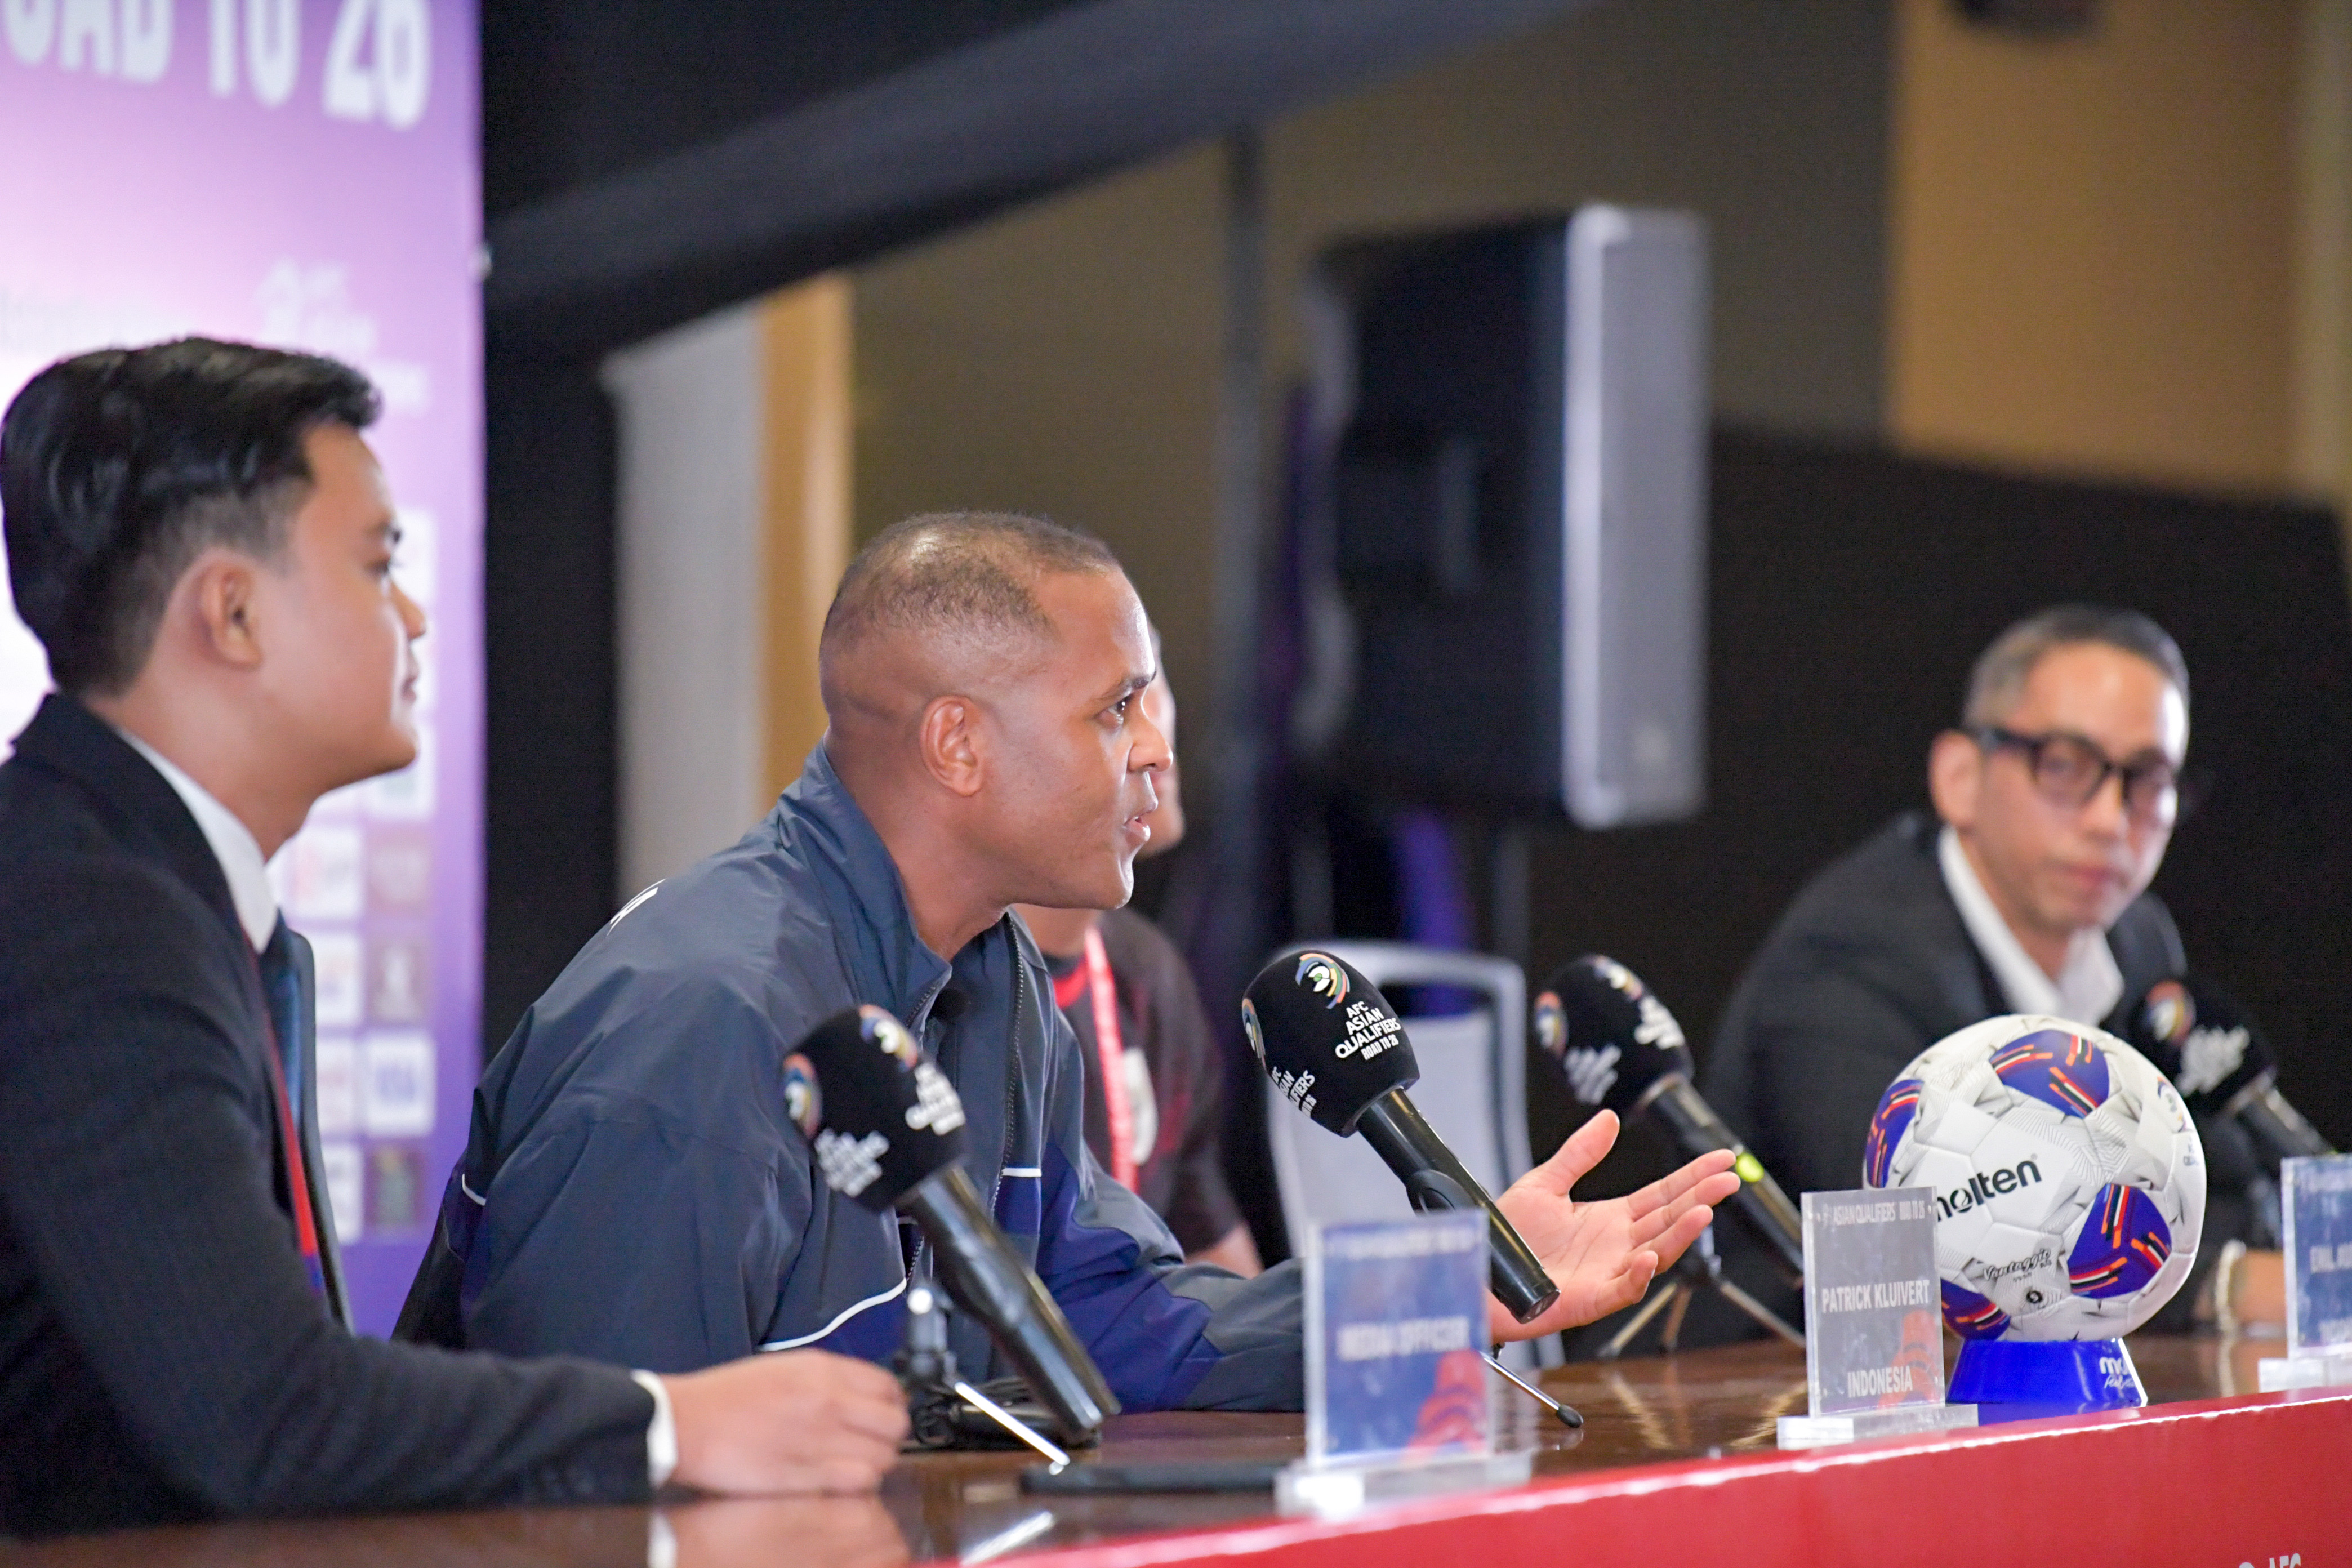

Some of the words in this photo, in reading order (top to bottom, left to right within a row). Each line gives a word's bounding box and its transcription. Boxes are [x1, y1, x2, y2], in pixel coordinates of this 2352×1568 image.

[1346, 1001, 1369, 1018] AFC
[1346, 1008, 1384, 1036] ASIAN
[1335, 1018, 1401, 1058] QUALIFIERS
[1361, 1041, 1383, 1060] ROAD
[1379, 1037, 1391, 1049] TO
[1388, 1034, 1399, 1046] 26
[1822, 1284, 1872, 1314] PATRICK
[1874, 1279, 1930, 1309] KLUIVERT
[1848, 1365, 1913, 1398] INDONESIA
